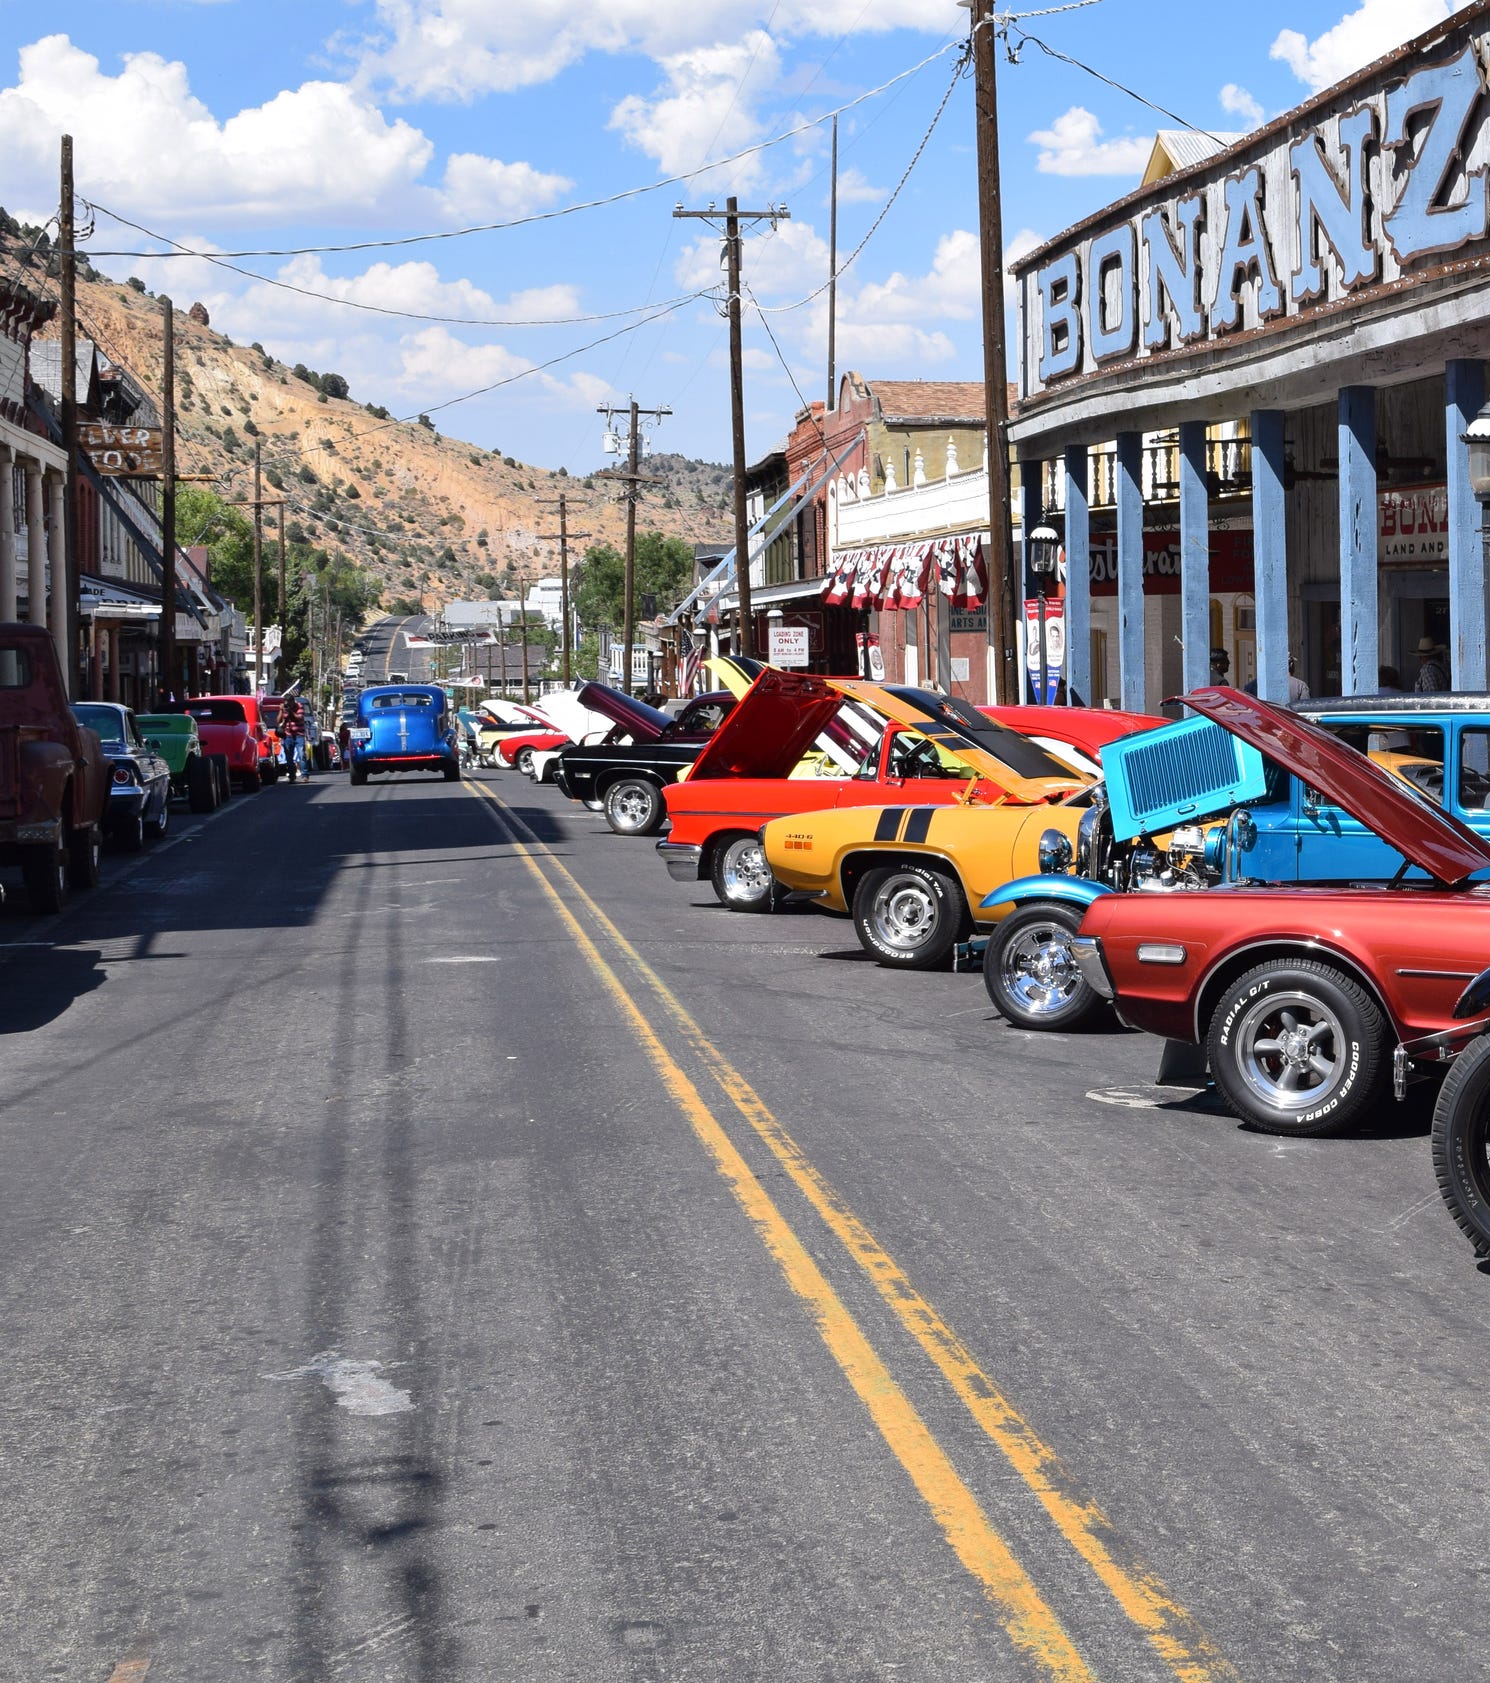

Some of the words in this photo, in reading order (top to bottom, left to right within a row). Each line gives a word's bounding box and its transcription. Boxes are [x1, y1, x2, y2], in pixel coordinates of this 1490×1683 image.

[1386, 543, 1415, 555] LAND
[1421, 542, 1444, 553] AND
[951, 617, 974, 629] ARTS
[427, 629, 474, 641] PARKING
[1221, 992, 1248, 1046] RADIAL
[1249, 980, 1271, 996] G/T
[1339, 1041, 1360, 1098] COOPER
[1296, 1098, 1339, 1123] COBRA
